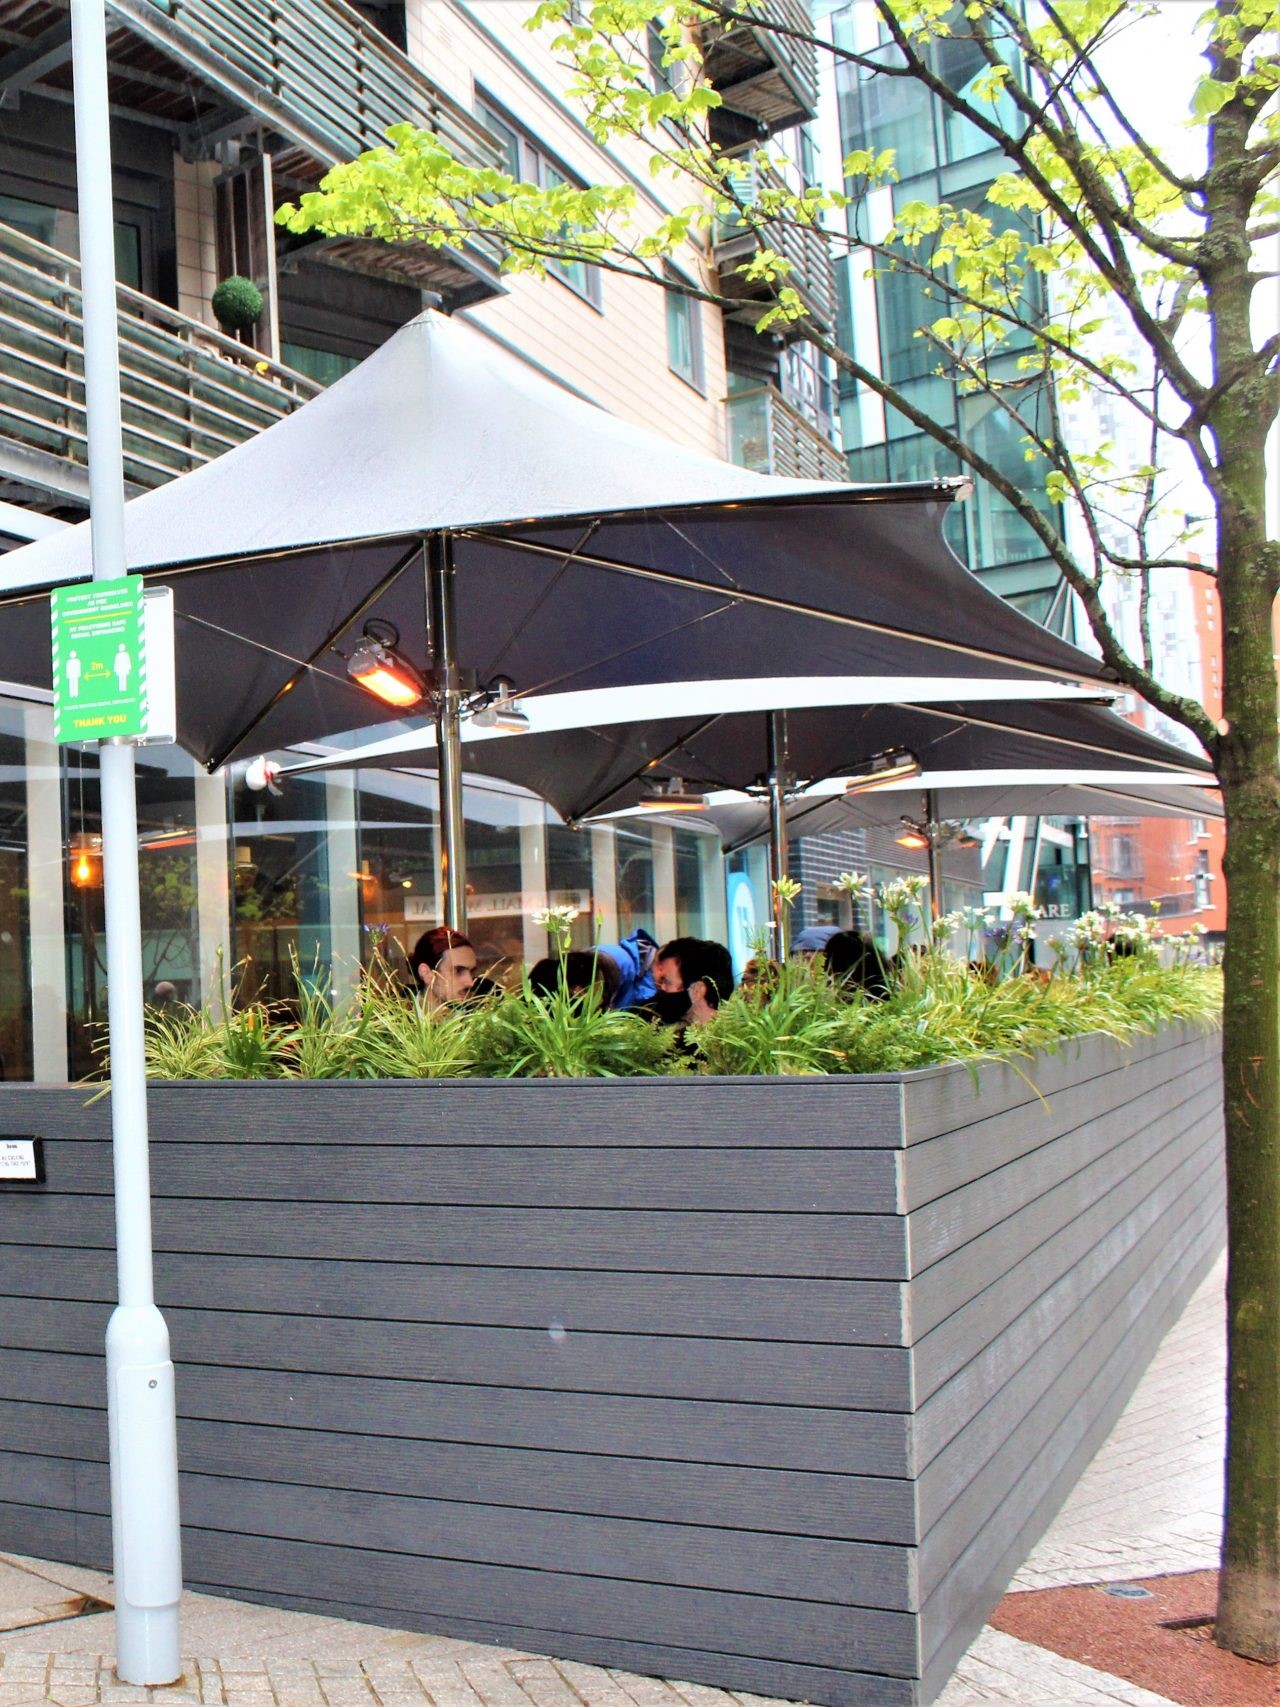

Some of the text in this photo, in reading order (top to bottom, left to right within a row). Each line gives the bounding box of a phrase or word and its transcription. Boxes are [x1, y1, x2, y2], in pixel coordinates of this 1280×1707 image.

[91, 661, 104, 671] 2m
[74, 713, 128, 728] THANK YOU
